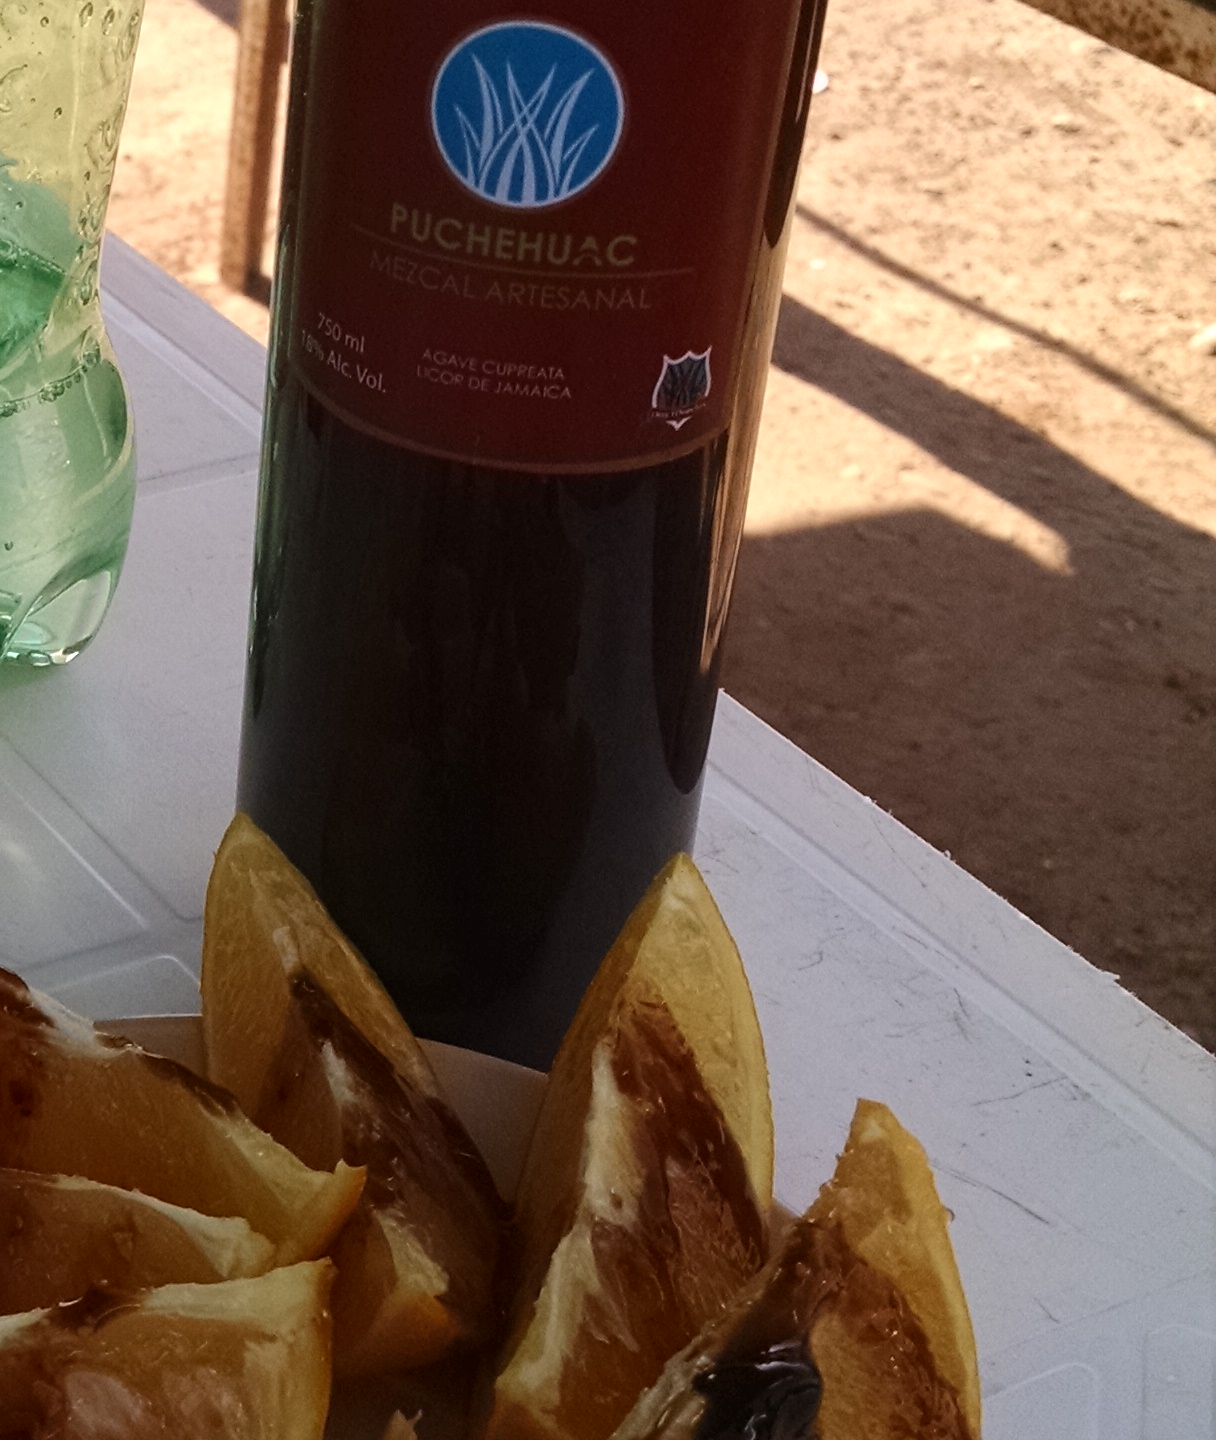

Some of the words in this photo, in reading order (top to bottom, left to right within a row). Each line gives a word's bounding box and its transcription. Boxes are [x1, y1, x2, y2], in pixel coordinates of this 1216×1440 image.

[390, 202, 639, 267] PUCHEHUAC
[369, 250, 476, 301] MEZCAL
[484, 279, 653, 312] ARTESANAL
[317, 311, 342, 342] 750
[344, 334, 366, 353] ml
[327, 350, 353, 379] Alc.
[356, 364, 387, 394] Vol.
[416, 365, 464, 385] LICOR
[468, 376, 489, 392] DE
[494, 381, 572, 400] JAMAICA
[422, 348, 477, 372] AGAVE
[481, 361, 565, 381] CUPREATA
